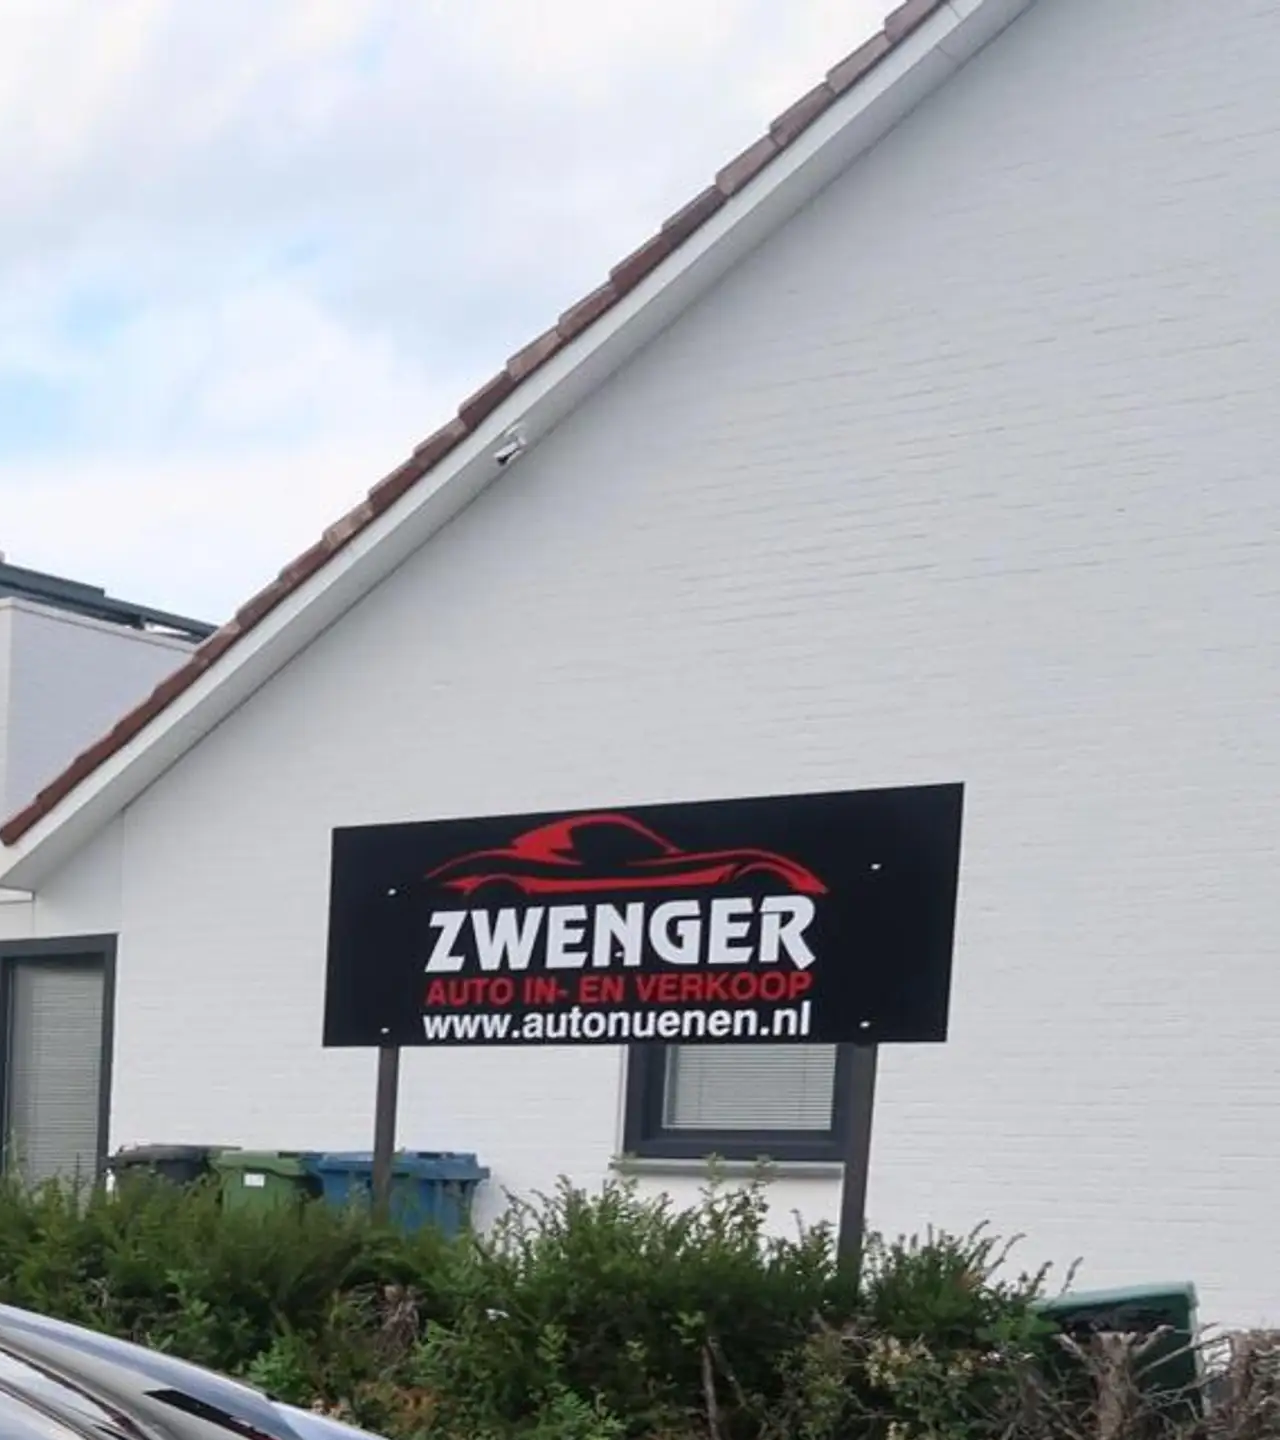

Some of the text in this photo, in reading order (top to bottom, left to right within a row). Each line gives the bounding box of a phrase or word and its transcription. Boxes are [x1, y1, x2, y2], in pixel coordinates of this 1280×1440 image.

[425, 895, 816, 972] ZWENGER
[426, 971, 813, 1005] AUTO IN- EN VERKOOP
[423, 1000, 811, 1040] www.autonuenen.nl
